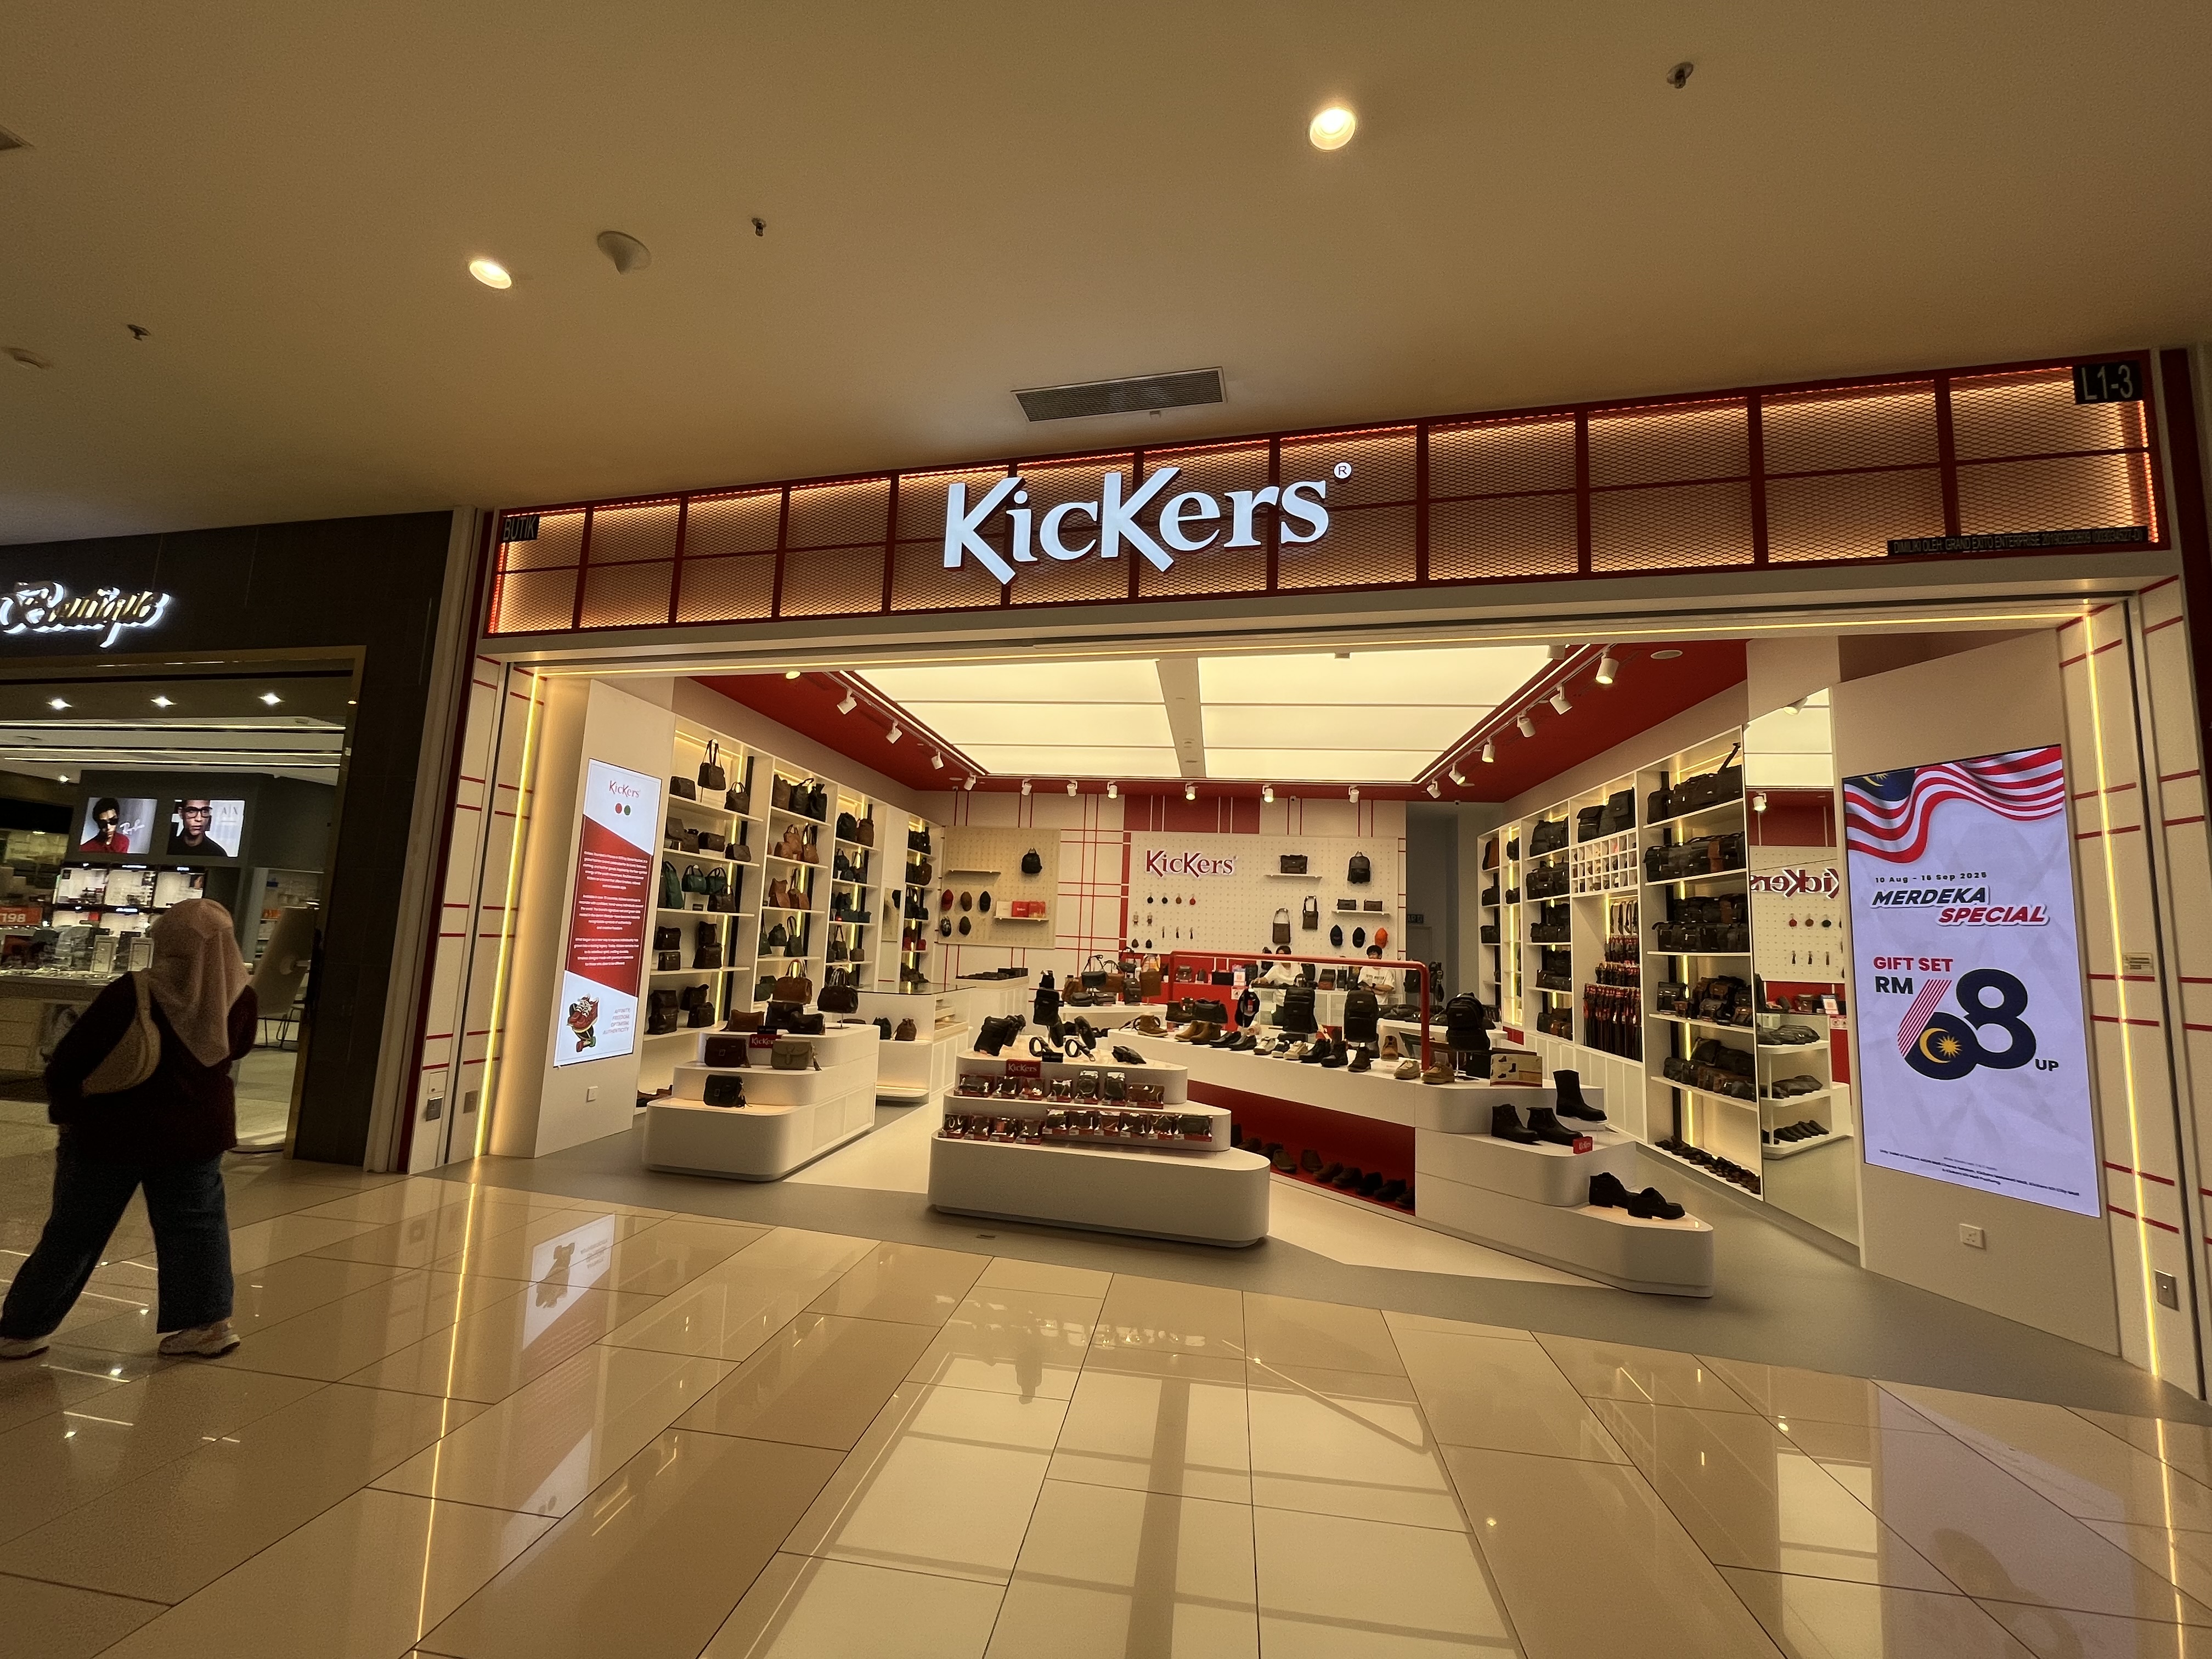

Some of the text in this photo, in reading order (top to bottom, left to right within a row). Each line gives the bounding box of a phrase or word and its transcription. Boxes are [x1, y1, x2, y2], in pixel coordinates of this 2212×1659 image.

[2081, 364, 2134, 400] L1-3
[503, 516, 537, 541] BUTIK
[1945, 537, 1971, 551] GRAND
[1995, 533, 2040, 549] ENTERPRISE
[1872, 887, 1985, 906] MERDEKA
[1938, 906, 2045, 923] SPECIAL
[1873, 956, 1954, 972] GIFT SET
[1875, 968, 2059, 1081] RM 68 UP
